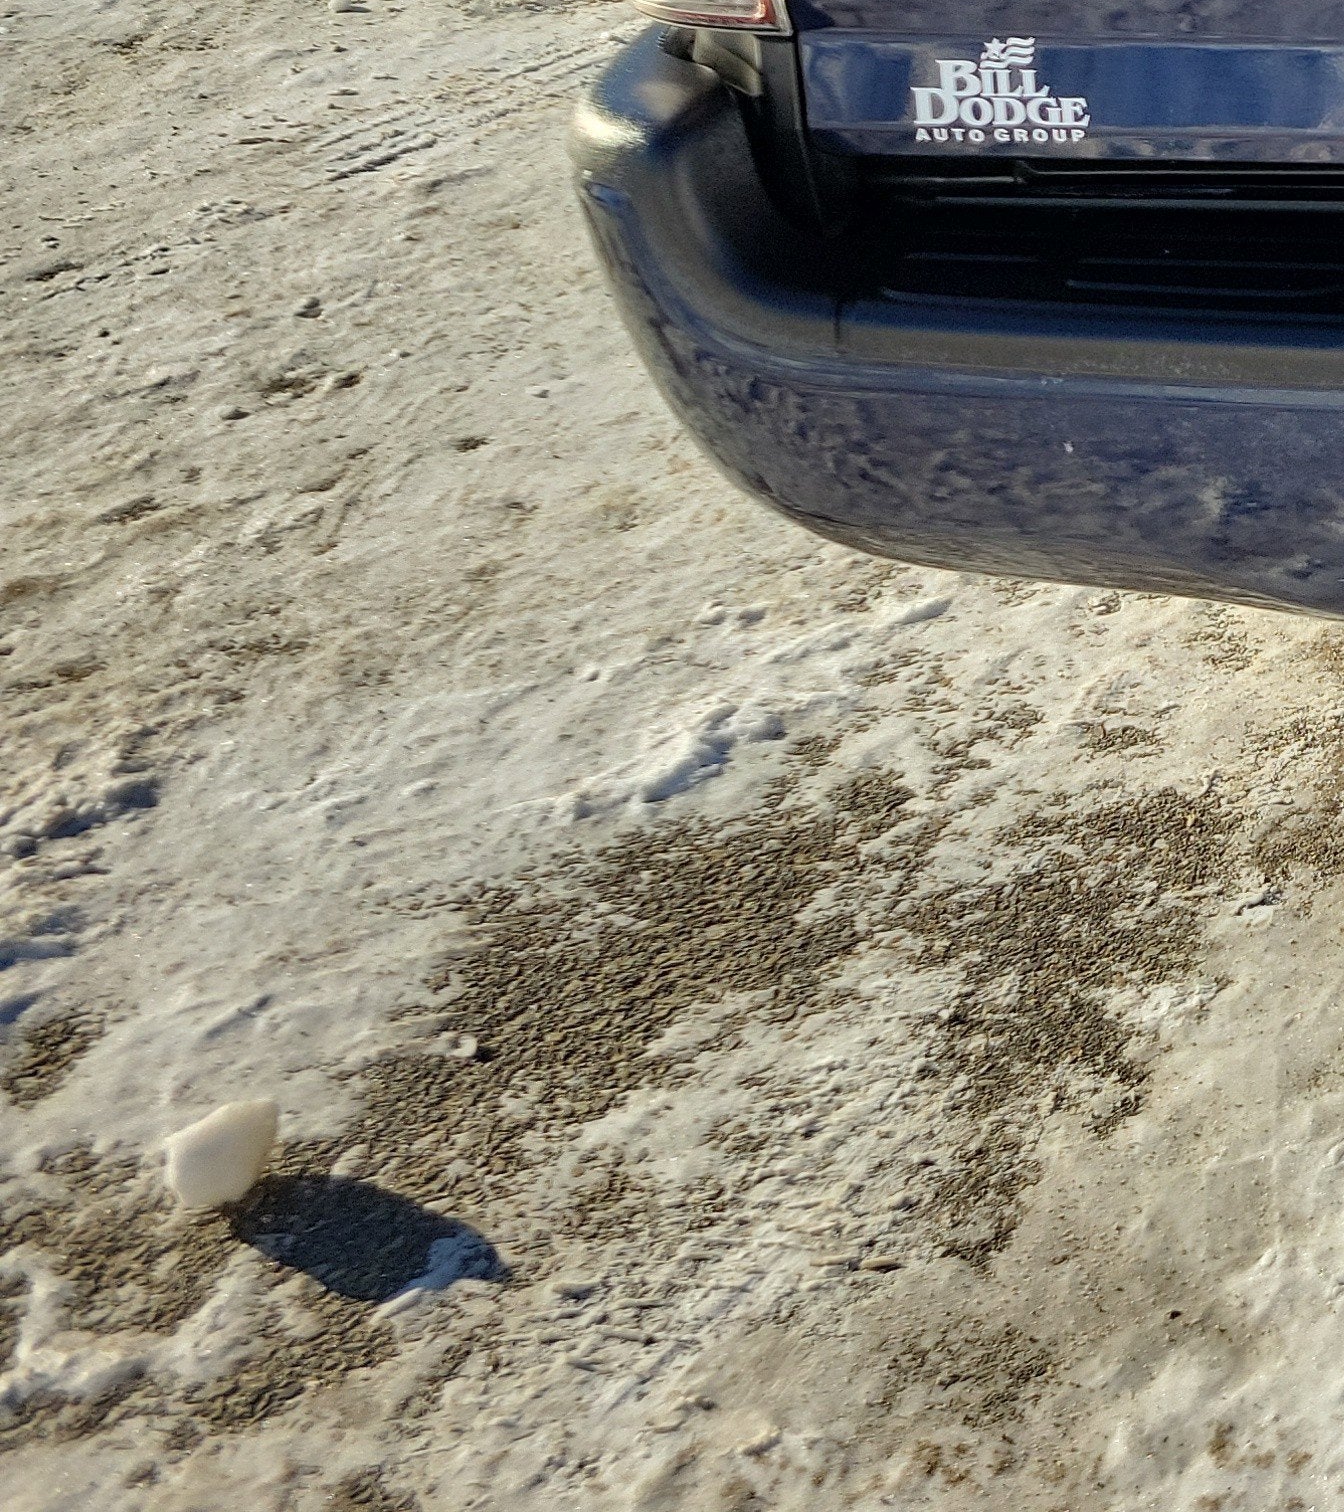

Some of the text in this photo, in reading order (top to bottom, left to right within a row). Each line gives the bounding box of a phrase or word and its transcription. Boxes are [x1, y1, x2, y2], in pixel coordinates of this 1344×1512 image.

[935, 59, 1050, 98] BILL
[910, 87, 1091, 128] DODGE
[915, 128, 1086, 143] AUTO GROUP
